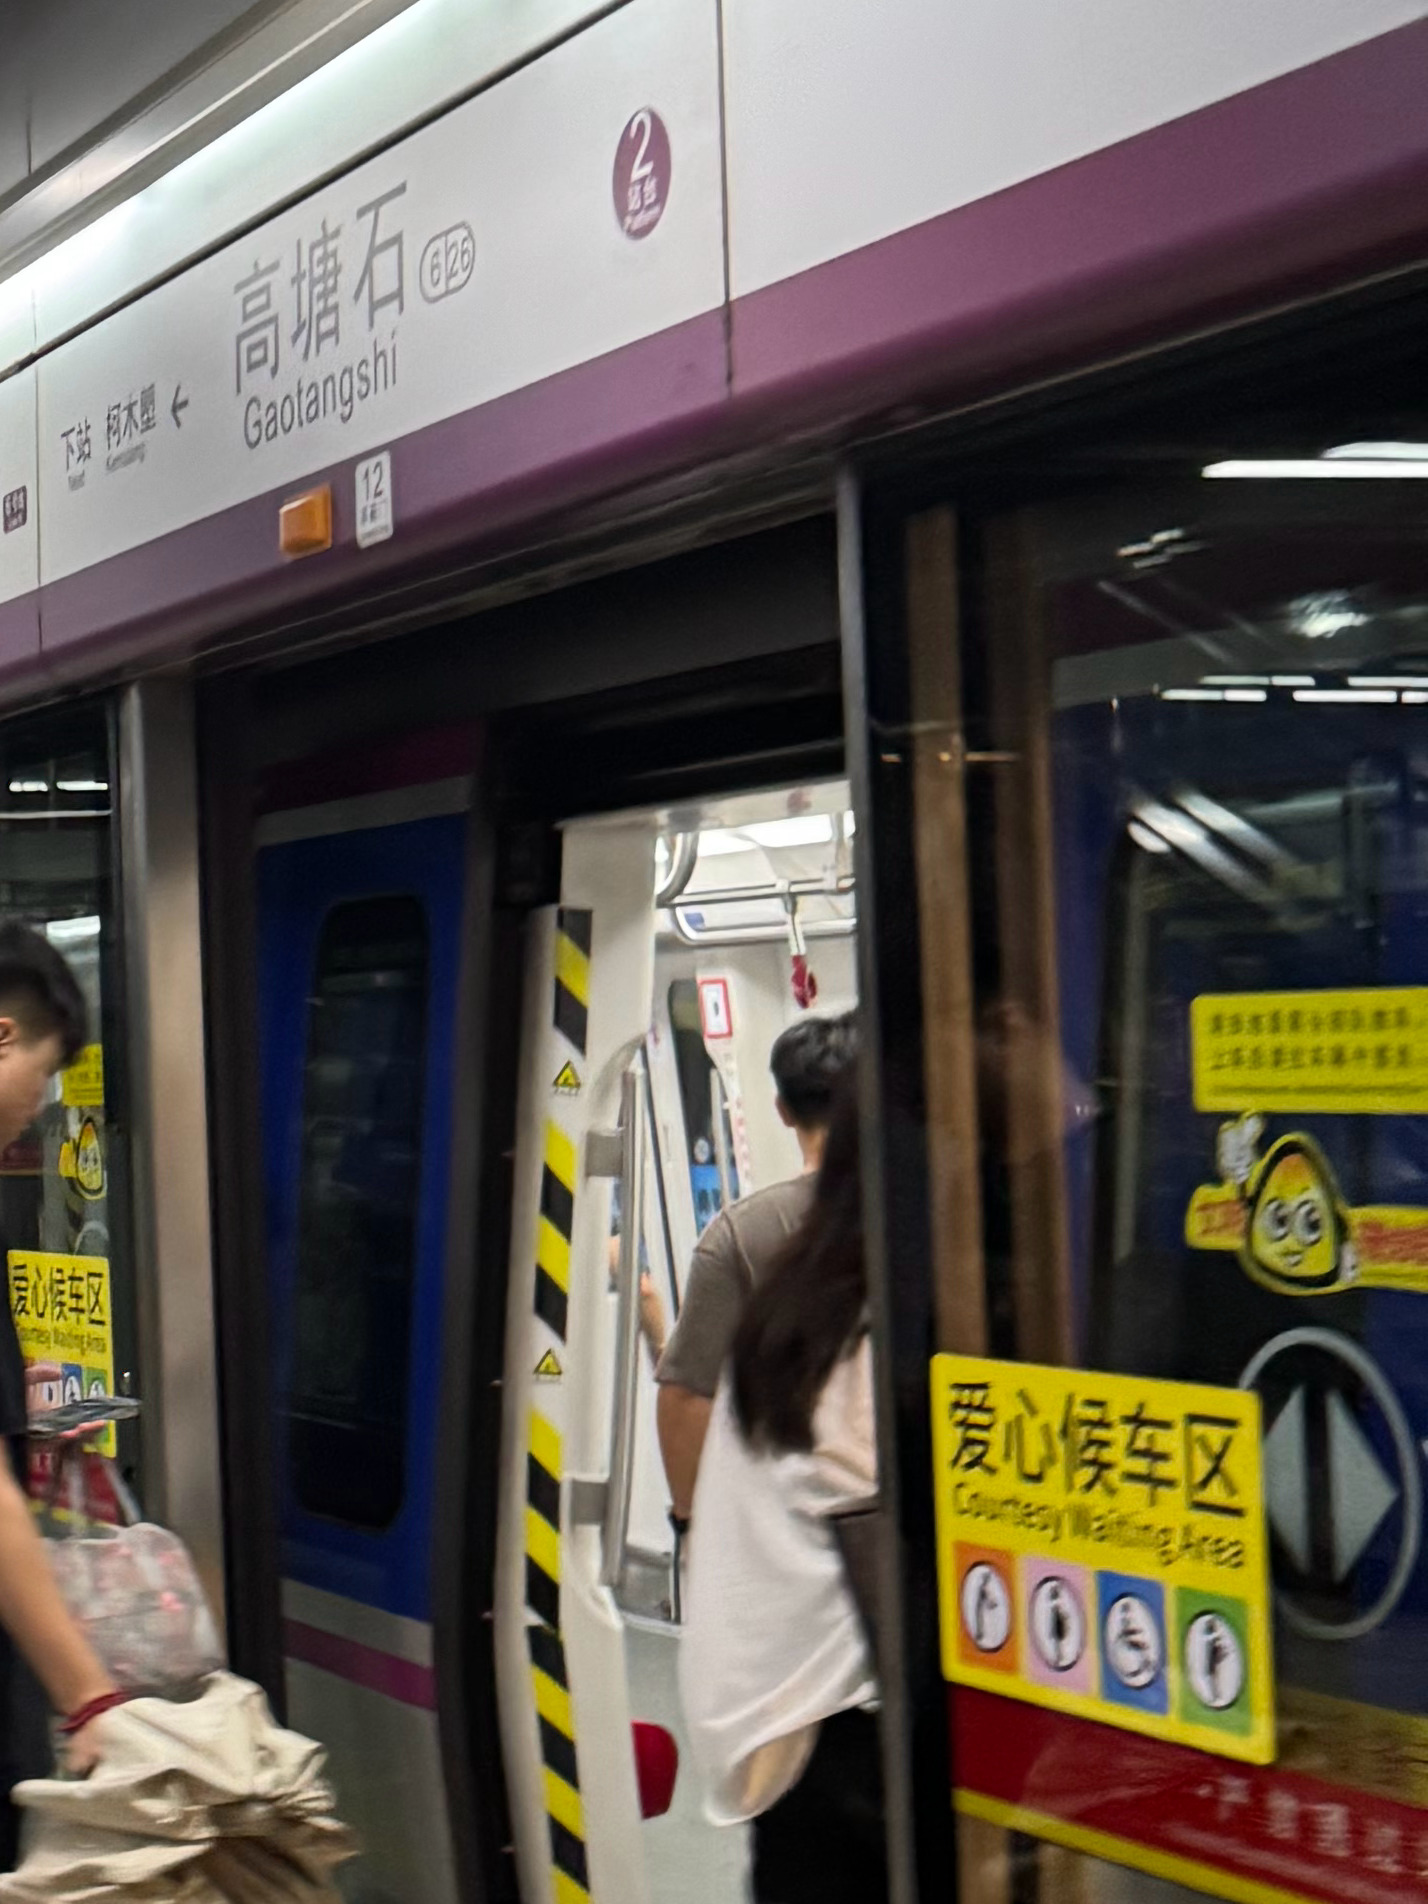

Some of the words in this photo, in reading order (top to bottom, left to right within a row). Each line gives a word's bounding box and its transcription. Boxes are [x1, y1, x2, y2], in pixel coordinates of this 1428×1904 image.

[629, 112, 654, 183] 2
[233, 179, 408, 396] 高塘石
[244, 326, 397, 450] Gaotangshi
[60, 416, 92, 473] 下站
[363, 460, 384, 501] 12
[12, 1262, 106, 1327] 爱心候车区
[948, 1381, 1245, 1518] 爱心候车区
